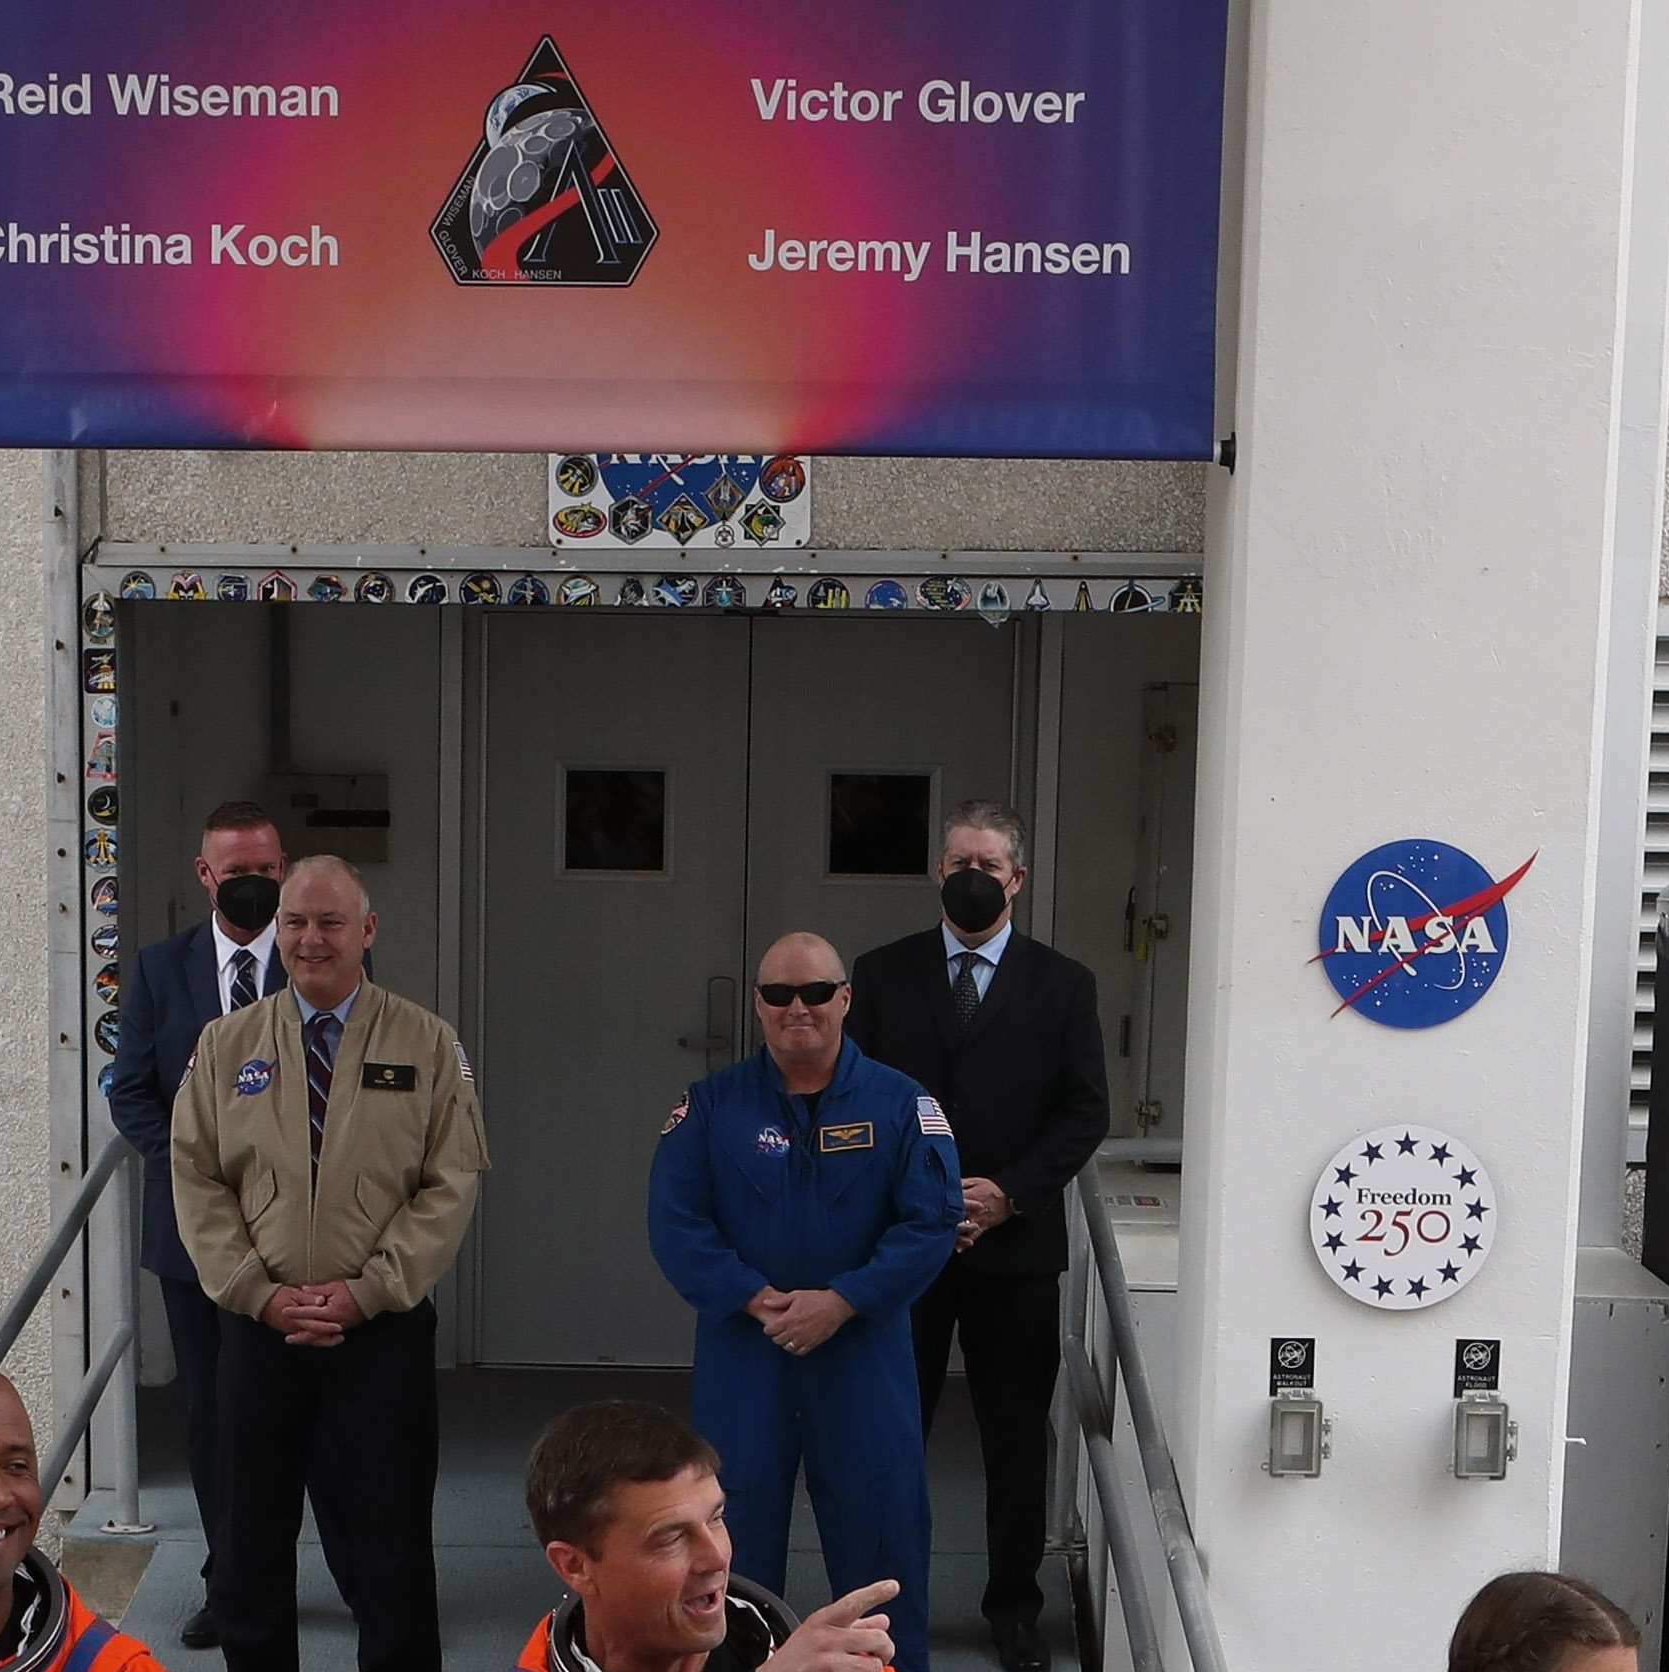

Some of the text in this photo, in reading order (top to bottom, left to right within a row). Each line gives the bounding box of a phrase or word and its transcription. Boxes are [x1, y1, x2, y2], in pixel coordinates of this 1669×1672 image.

[107, 74, 338, 118] Wiseman
[750, 78, 1085, 124] Victor Glover
[442, 175, 475, 228] WISEMAN
[211, 223, 339, 268] Koch
[438, 230, 469, 276] GLOVER
[748, 229, 1130, 282] Jeremy Hansen
[471, 269, 562, 280] KOCH HANSEN
[1334, 915, 1499, 954] NASA
[237, 1071, 270, 1084] NASA
[758, 1134, 790, 1147] NASA
[1356, 1187, 1453, 1206] Freedom
[1355, 1208, 1451, 1257] 250
[1272, 1373, 1312, 1381] ASTRONAUT
